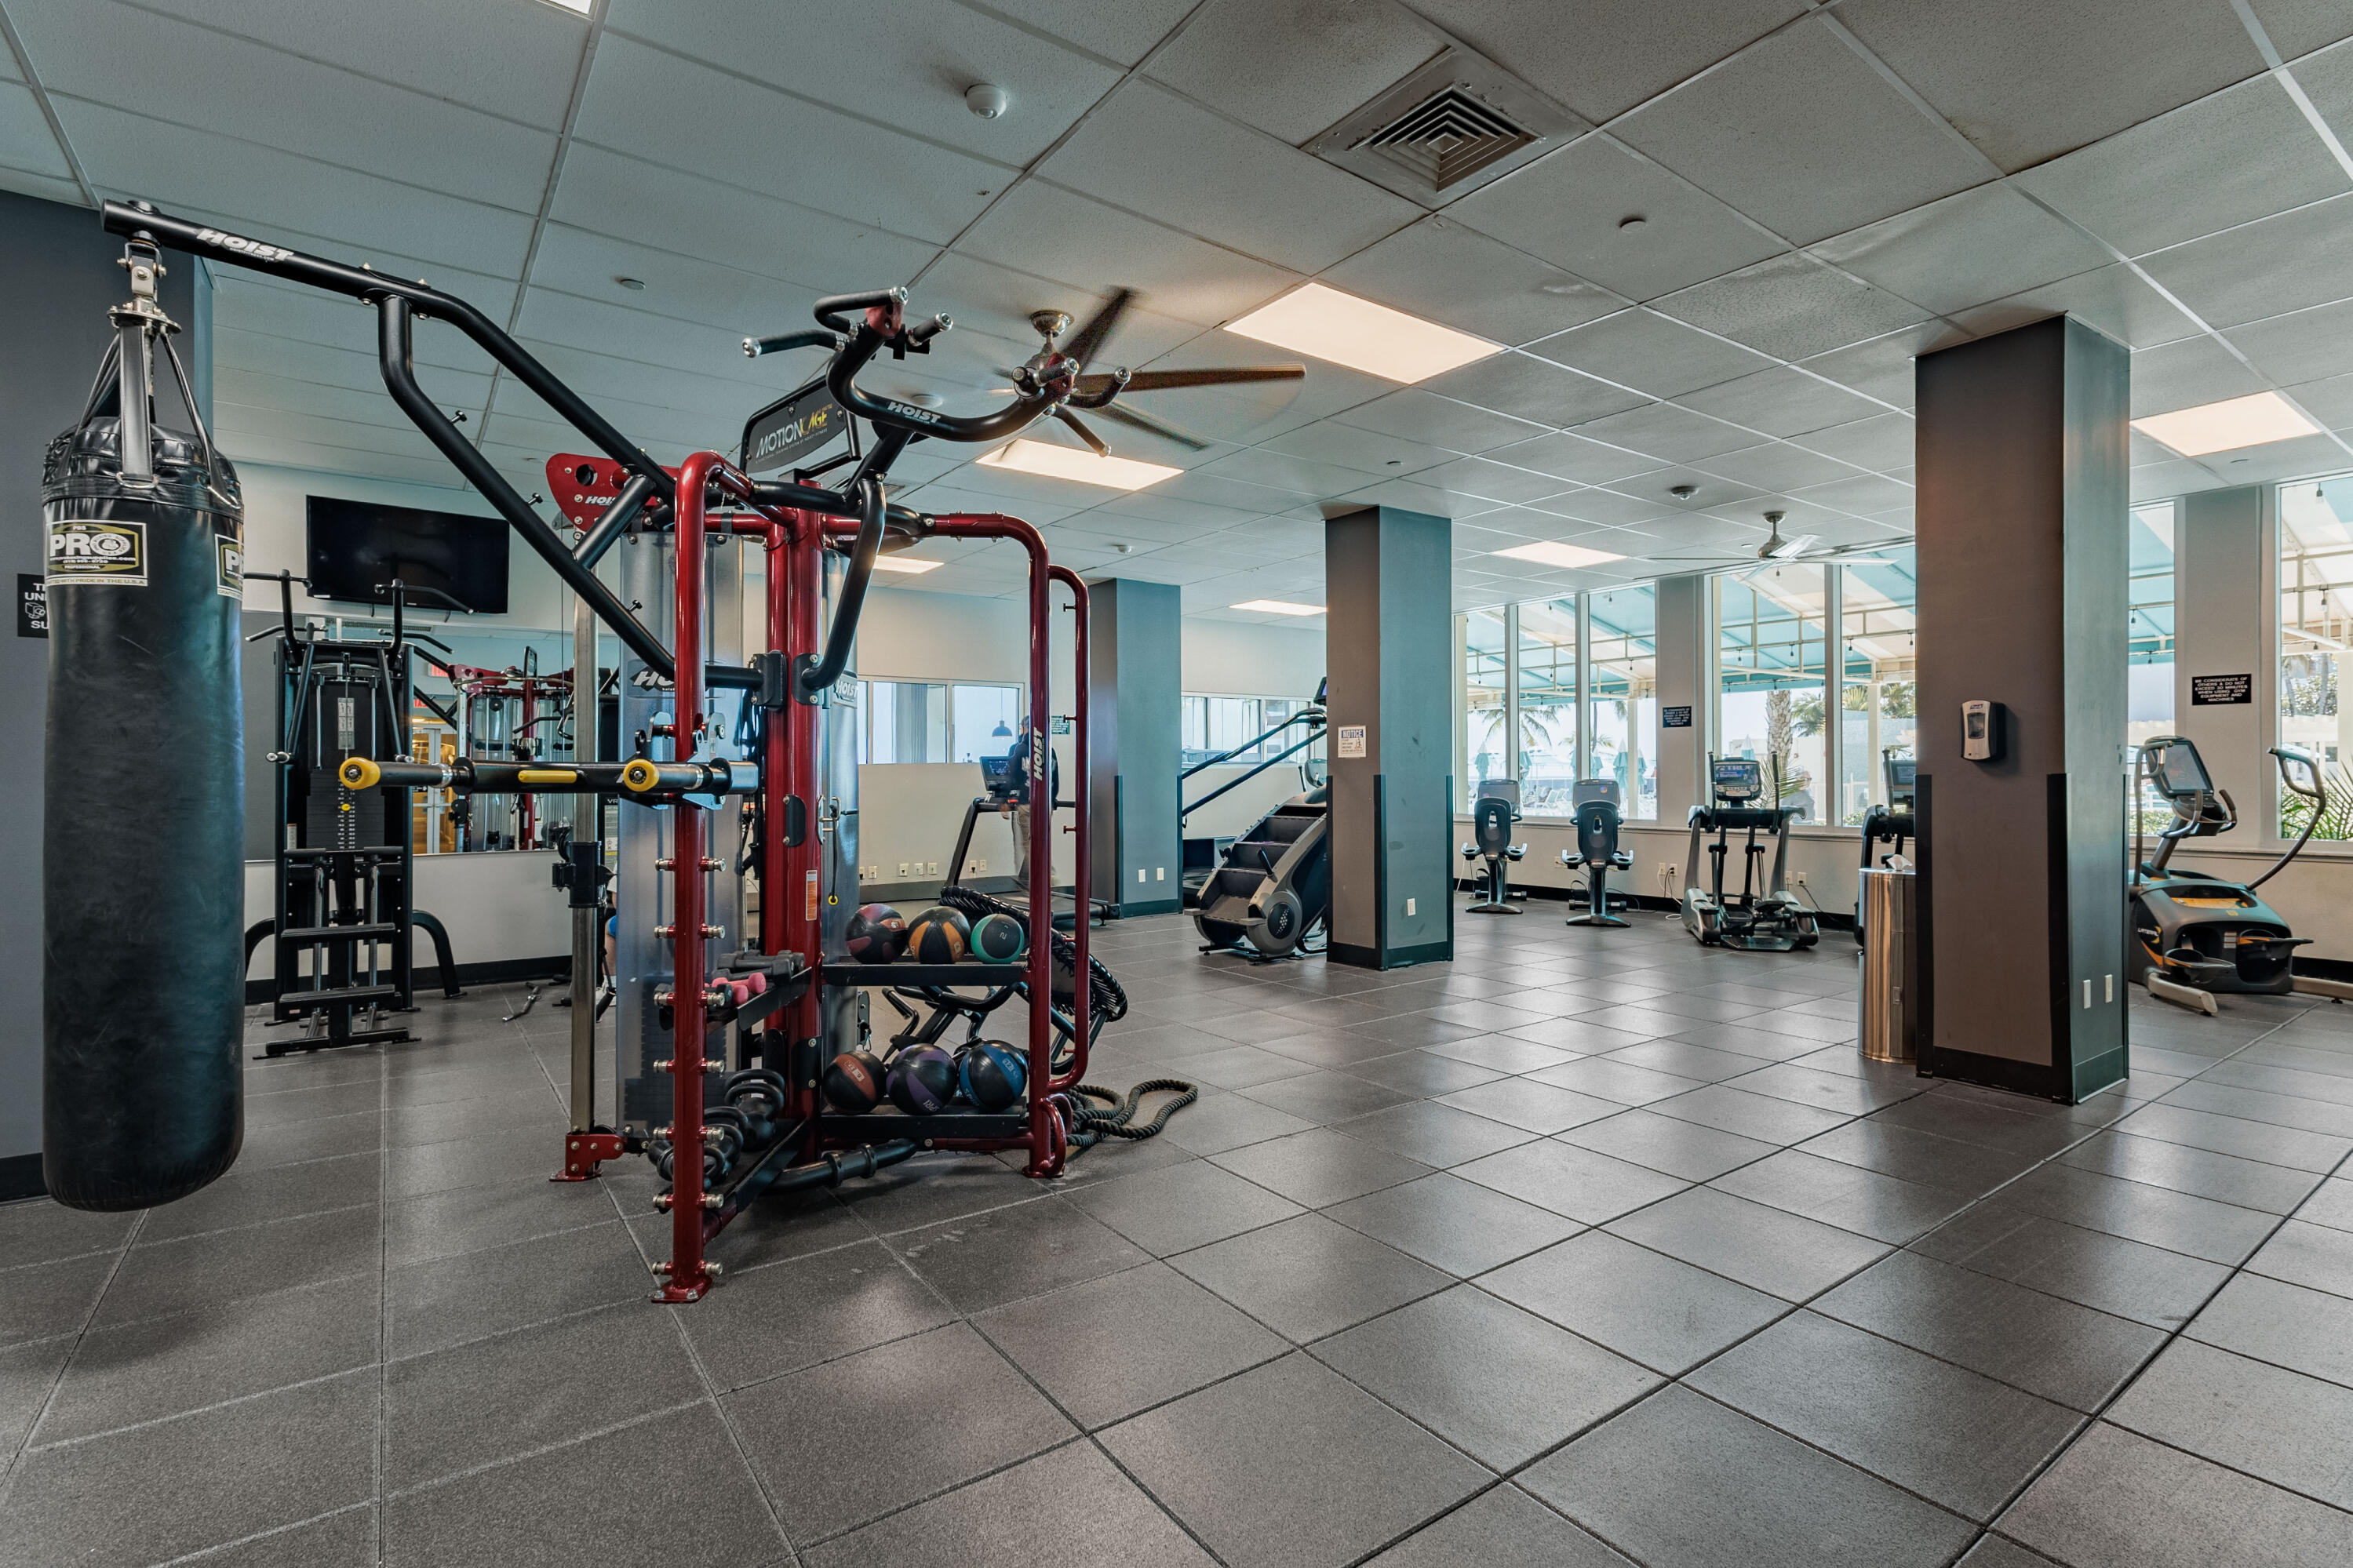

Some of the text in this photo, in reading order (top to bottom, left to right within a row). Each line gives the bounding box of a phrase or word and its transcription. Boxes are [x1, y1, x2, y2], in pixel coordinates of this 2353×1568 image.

[196, 228, 294, 261] HOIST
[887, 402, 941, 423] HOIST
[585, 496, 615, 504] HOI
[50, 533, 130, 556] PRO
[836, 679, 859, 698] HOIST
[1033, 727, 1042, 780] HOIST
